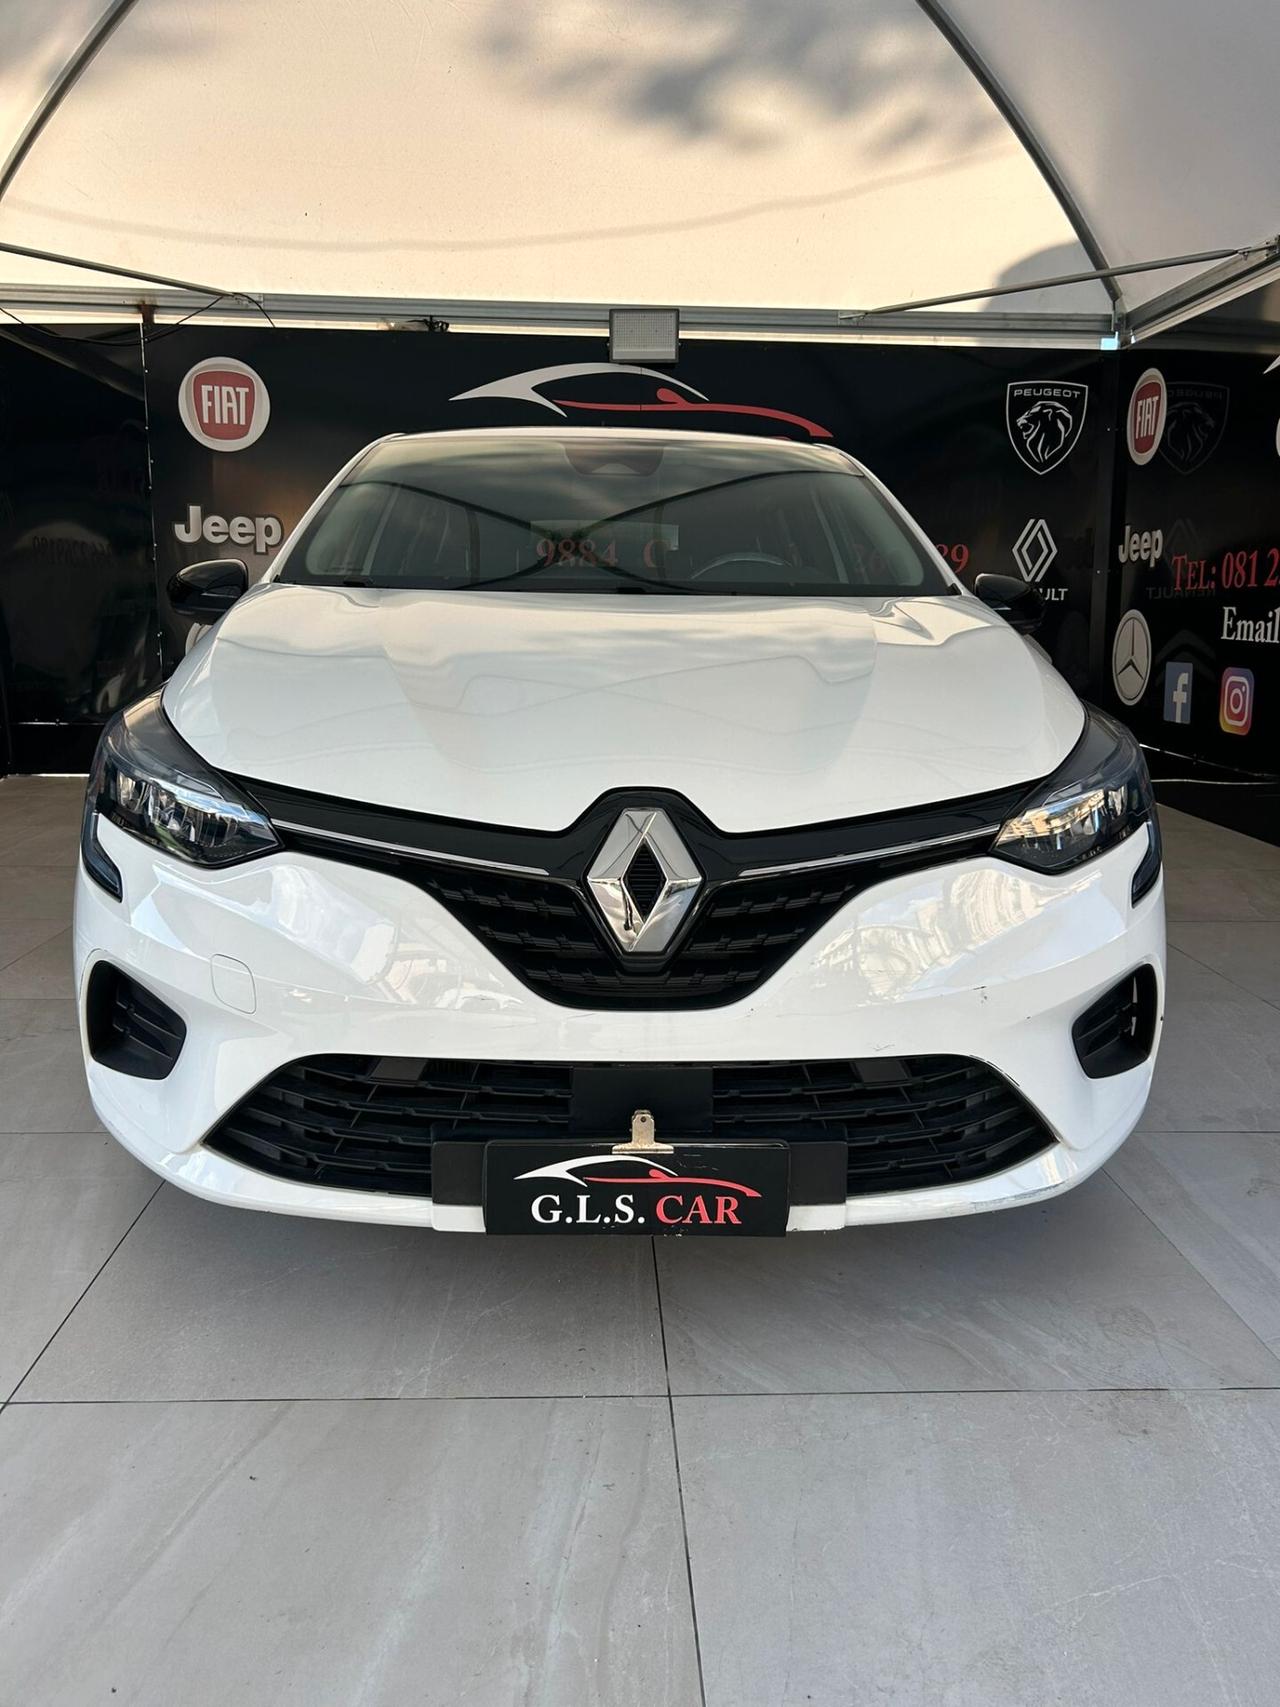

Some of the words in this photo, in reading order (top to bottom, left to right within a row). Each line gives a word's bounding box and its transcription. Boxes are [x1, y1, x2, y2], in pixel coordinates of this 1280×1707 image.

[201, 384, 249, 426] FIAT
[1013, 388, 1081, 399] PEUGEOT
[1135, 396, 1159, 440] FIAT
[173, 505, 283, 554] Jeep
[1118, 525, 1163, 568] Jeep
[1221, 550, 1258, 589] 081
[531, 1194, 646, 1225] G.L.S.
[655, 1194, 742, 1225] CAR
